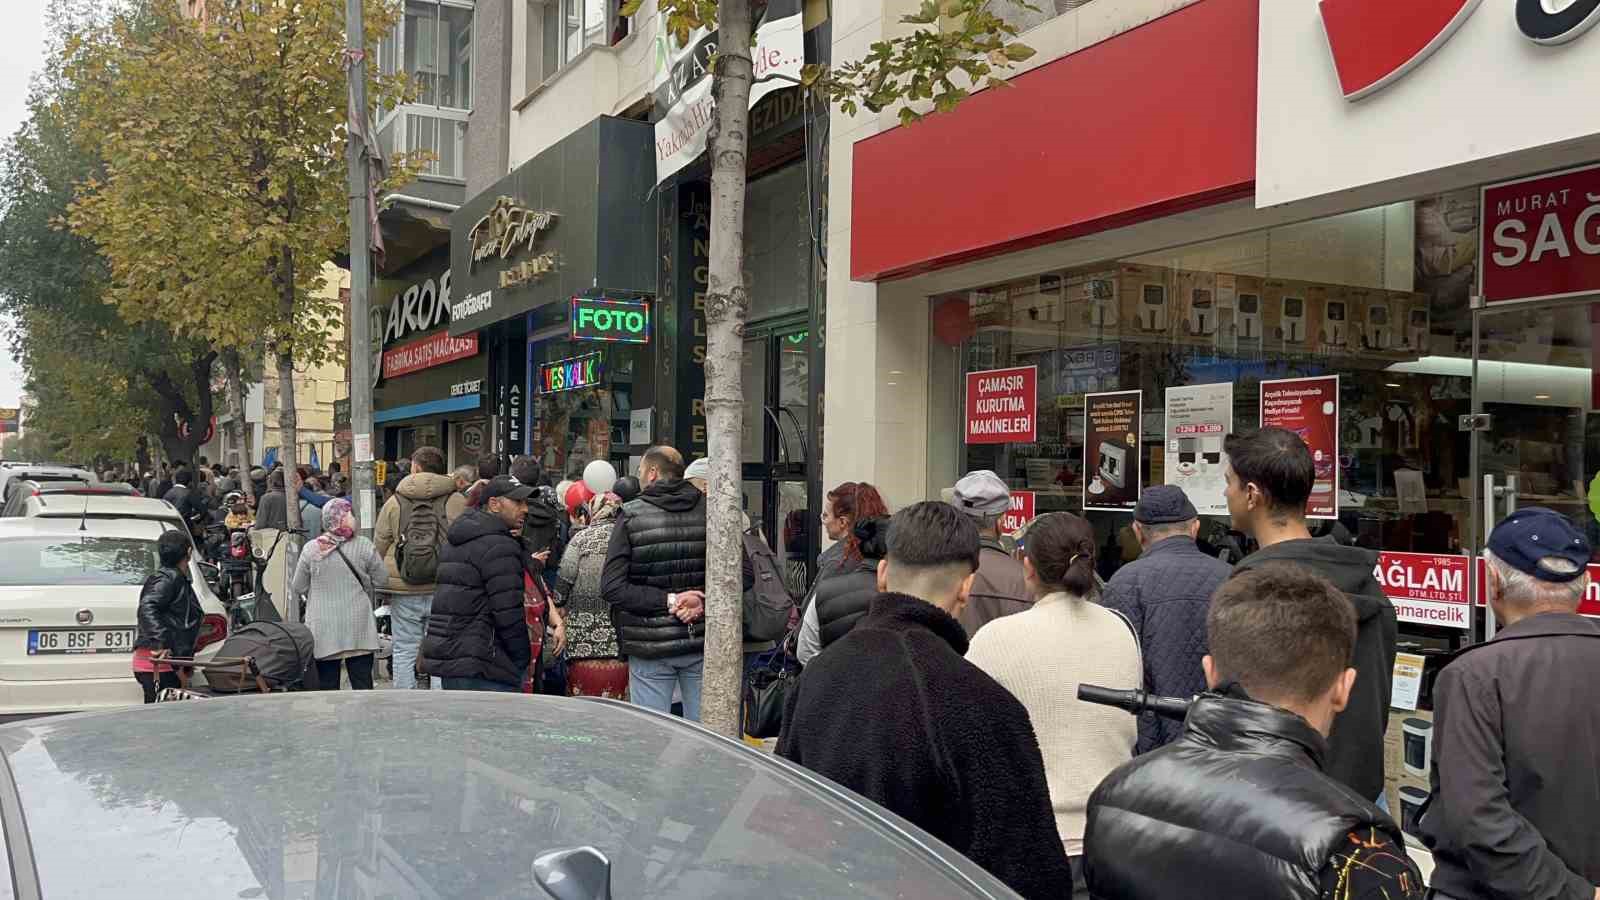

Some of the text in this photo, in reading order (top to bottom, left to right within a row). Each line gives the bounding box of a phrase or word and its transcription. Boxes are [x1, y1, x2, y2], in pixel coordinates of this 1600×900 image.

[1497, 189, 1571, 217] MURAT
[579, 308, 643, 332] FOTO
[978, 375, 1024, 397] ÇAMAŞIR
[510, 384, 520, 441] ACELE
[976, 397, 1025, 414] KURUTMA
[970, 414, 1031, 435] MAKİNELERİ
[1372, 559, 1463, 592] AĞLAM
[1394, 605, 1464, 623] amarcelik
[39, 633, 58, 648] 06
[68, 632, 96, 648] BSF
[105, 632, 131, 647] 831
